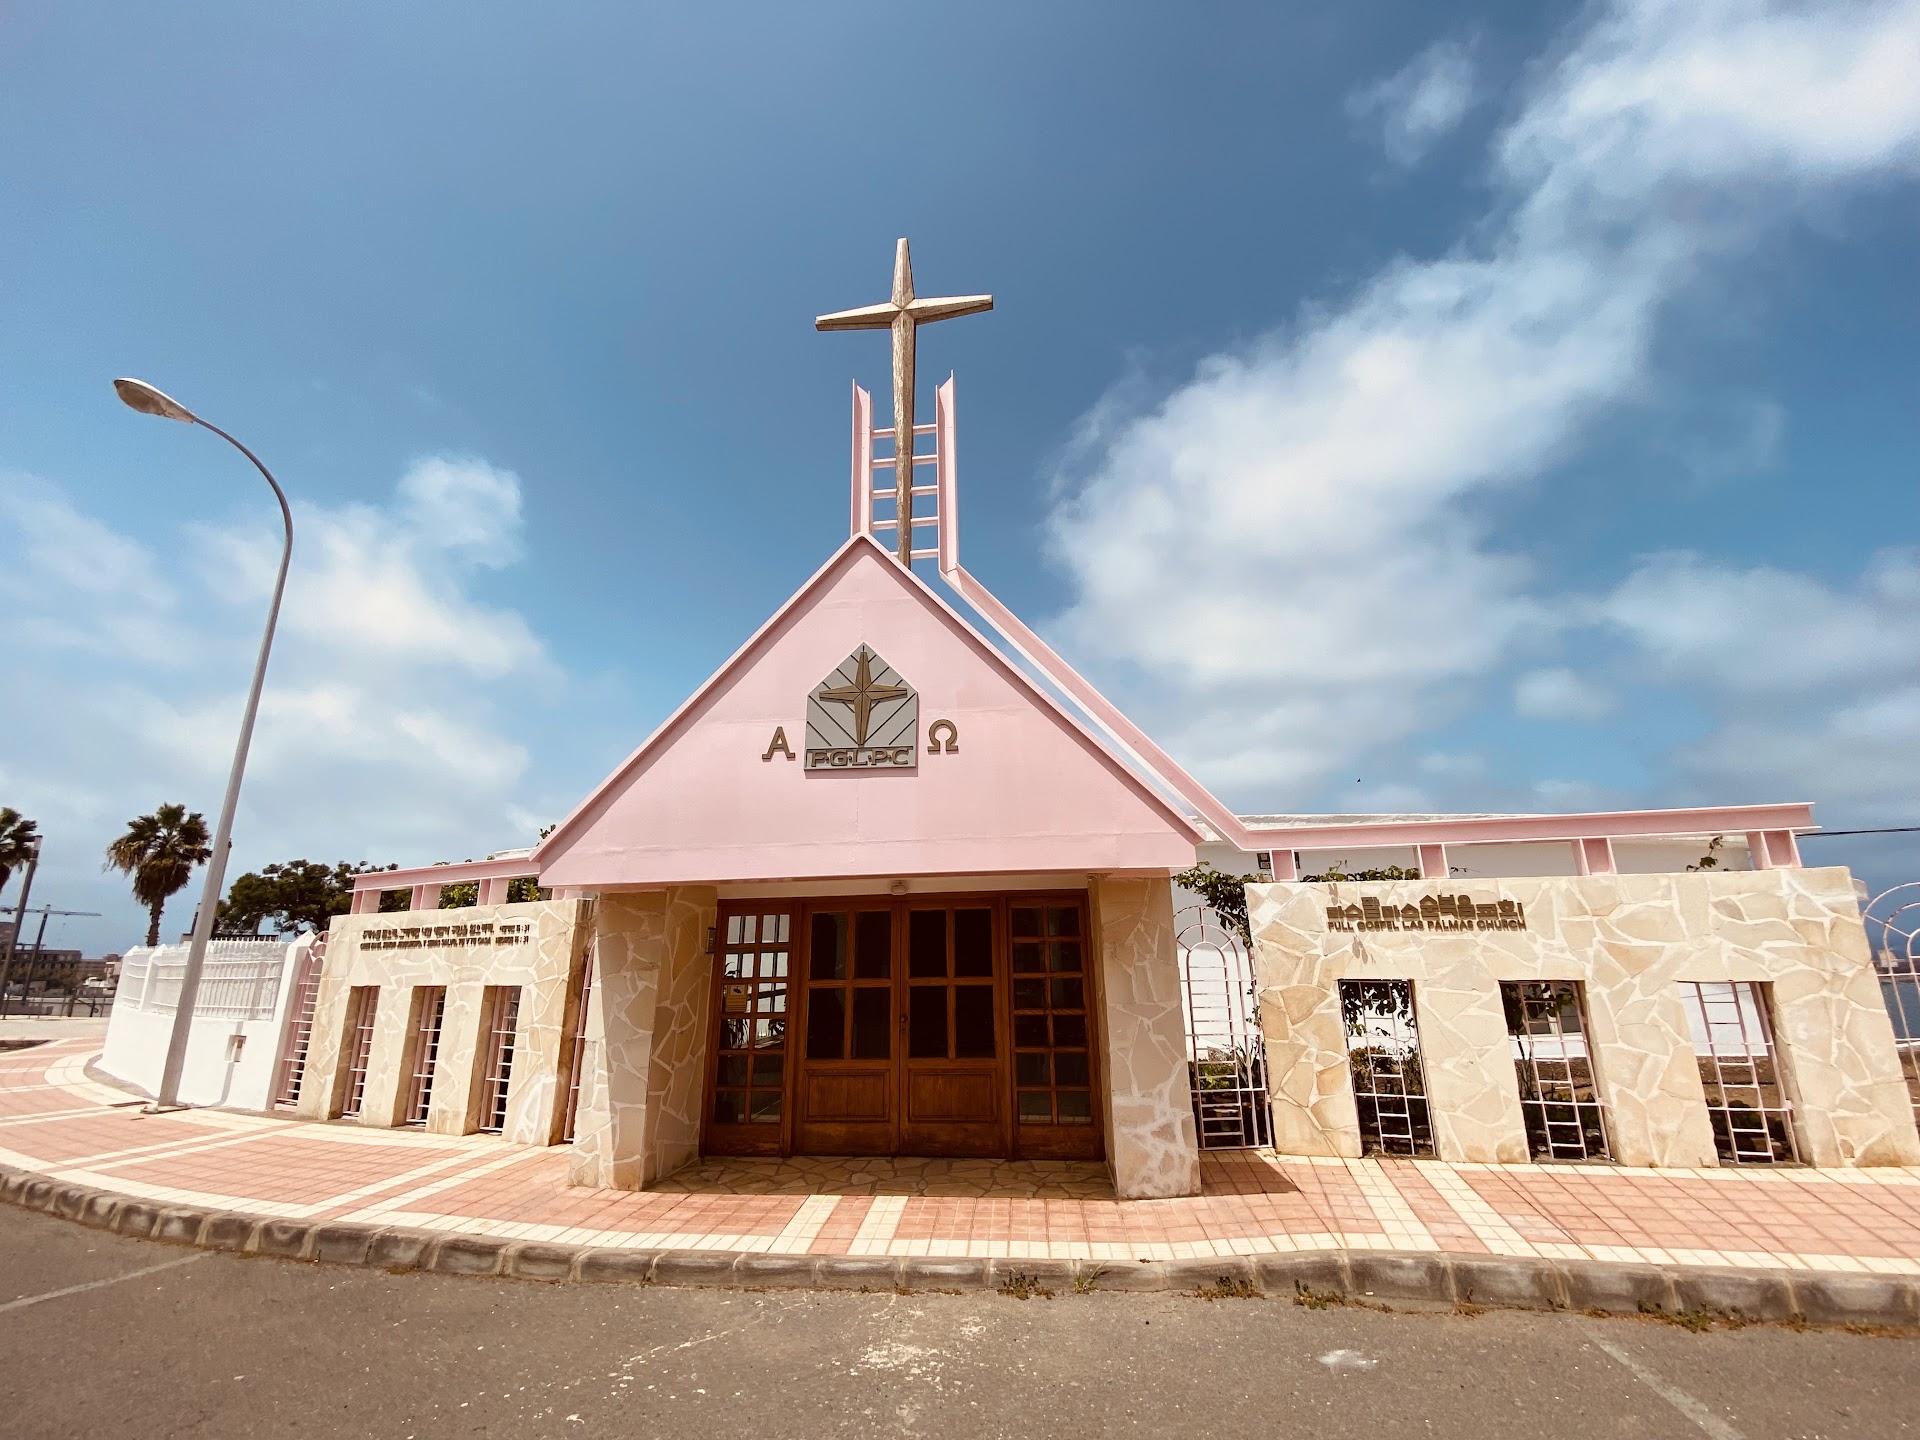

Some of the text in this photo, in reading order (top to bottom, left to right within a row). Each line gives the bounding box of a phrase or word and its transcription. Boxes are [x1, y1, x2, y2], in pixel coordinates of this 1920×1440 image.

[927, 719, 959, 753] Ω
[1328, 919, 1527, 932] FULL GOSPEL LAS PALMAS CHURCH
